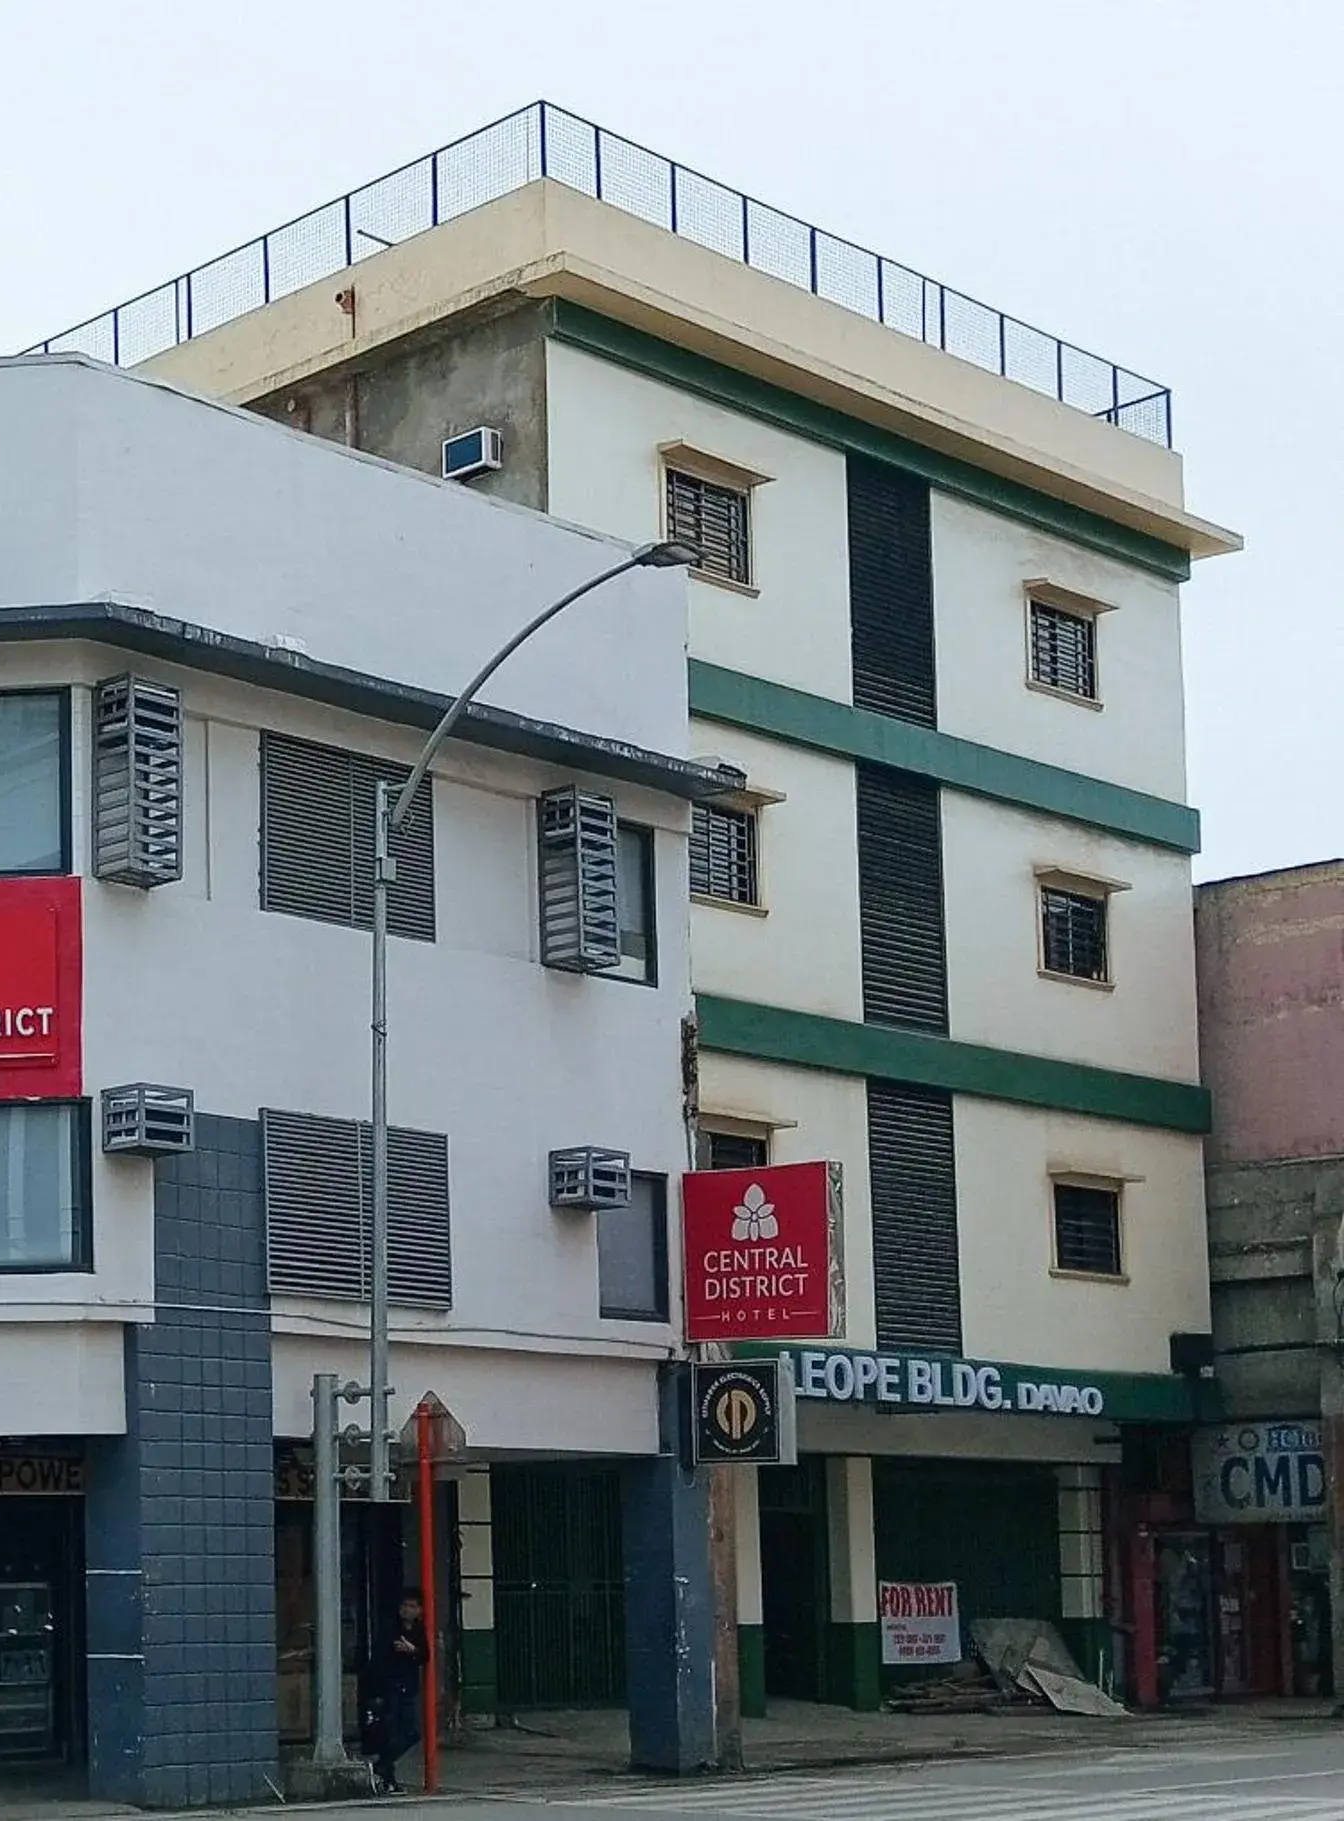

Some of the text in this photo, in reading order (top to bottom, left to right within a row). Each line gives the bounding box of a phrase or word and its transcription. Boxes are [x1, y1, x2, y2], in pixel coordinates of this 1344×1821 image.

[704, 1245, 808, 1273] CENTRAL
[705, 1274, 808, 1300] DISTRICT
[721, 1308, 791, 1323] HOTEL
[908, 1360, 1011, 1410] BLDG.
[1017, 1382, 1103, 1415] DAVAO
[1221, 1454, 1325, 1509] CMD
[882, 1585, 954, 1617] FOR RENT
